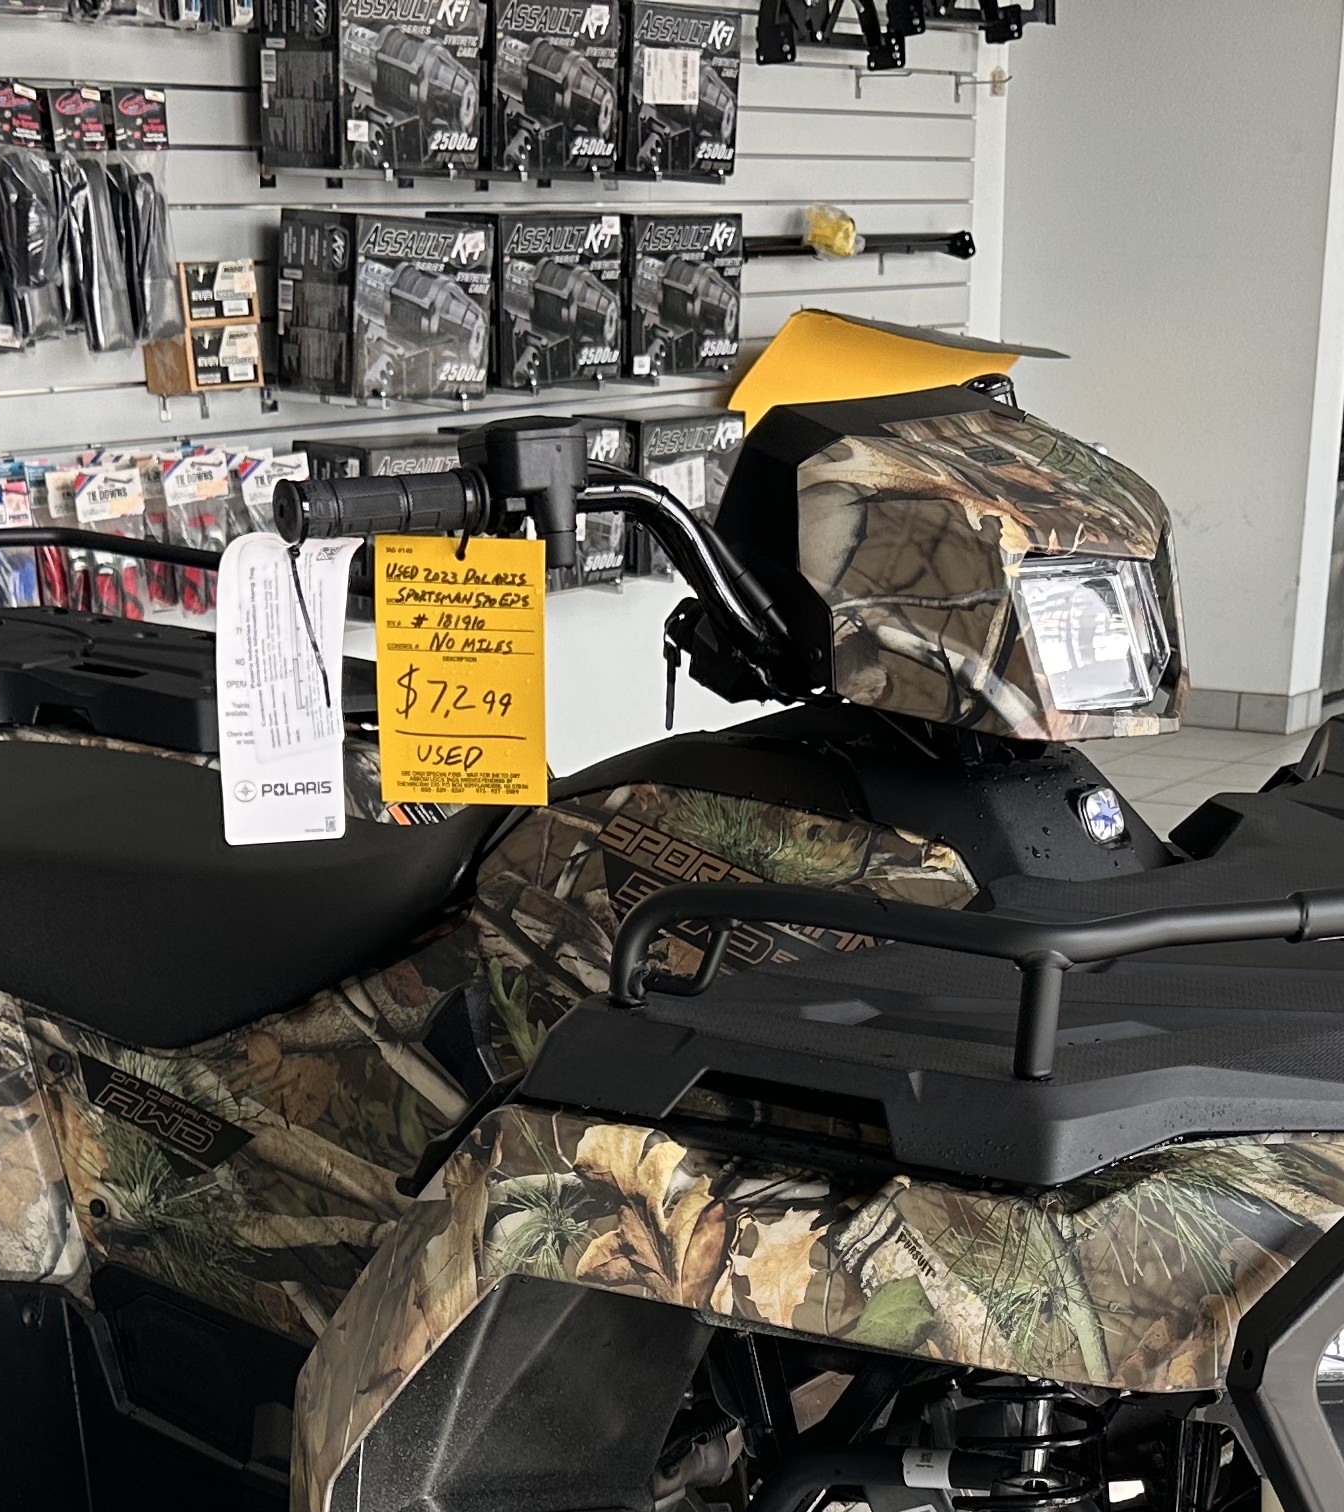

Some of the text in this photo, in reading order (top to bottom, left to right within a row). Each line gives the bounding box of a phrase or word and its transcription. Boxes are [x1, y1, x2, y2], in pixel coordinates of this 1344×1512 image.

[497, 0, 583, 34] ASSAULT
[634, 10, 711, 45] ASSAULT
[430, 131, 478, 152] 2500LB
[571, 137, 615, 158] 2500LB
[696, 141, 735, 161] 2500LB
[359, 223, 454, 260] ASSAULT
[504, 223, 586, 254] ASSAULT
[637, 222, 711, 251] ASSAULT
[439, 362, 485, 382] 2500LB
[645, 428, 714, 455] ASSAULT
[386, 562, 419, 580] USED
[423, 568, 457, 584] 2023
[395, 587, 474, 605] SPORTSMAN
[499, 592, 530, 608] EPS
[429, 631, 513, 655] NO MILES
[417, 744, 483, 771] USED
[261, 780, 332, 797] POLARIS
[94, 1083, 215, 1153] AWD
